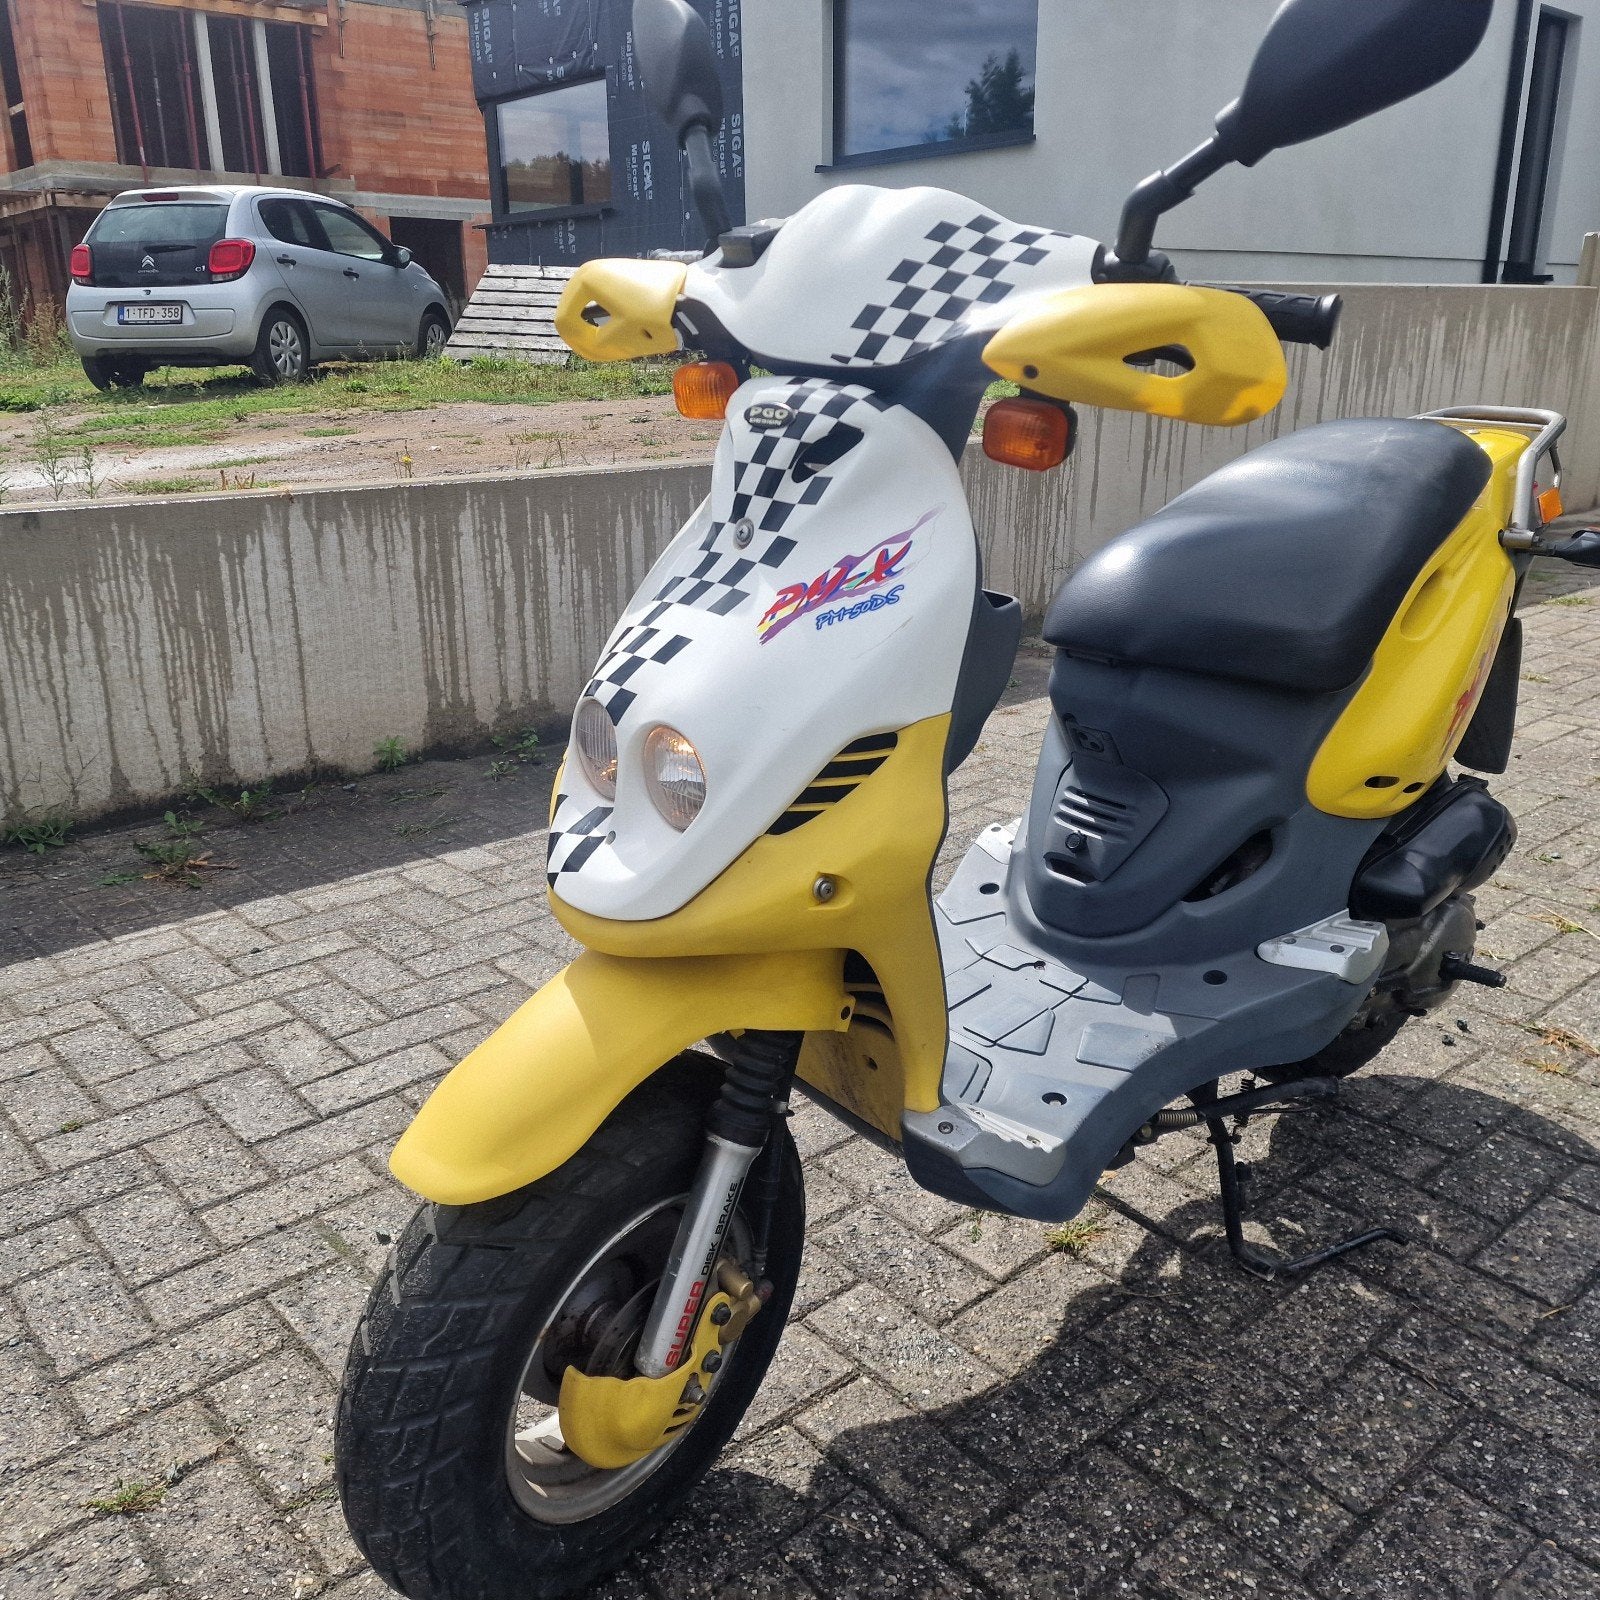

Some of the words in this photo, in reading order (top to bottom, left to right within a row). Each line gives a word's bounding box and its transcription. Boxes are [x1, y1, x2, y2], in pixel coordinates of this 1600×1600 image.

[473, 12, 482, 62] Majcoat
[482, 8, 492, 55] SIGA
[626, 31, 634, 87] Majcoat
[642, 140, 652, 191] SIGA
[732, 113, 741, 168] SIGA
[631, 143, 640, 198] Majcoat
[126, 307, 180, 319] 1-TFD-358
[750, 406, 789, 420] PGO
[816, 585, 905, 630] PM-50DS
[665, 1280, 705, 1368] SUPER
[701, 1240, 718, 1276] DISK
[715, 1182, 738, 1235] BRAKE
